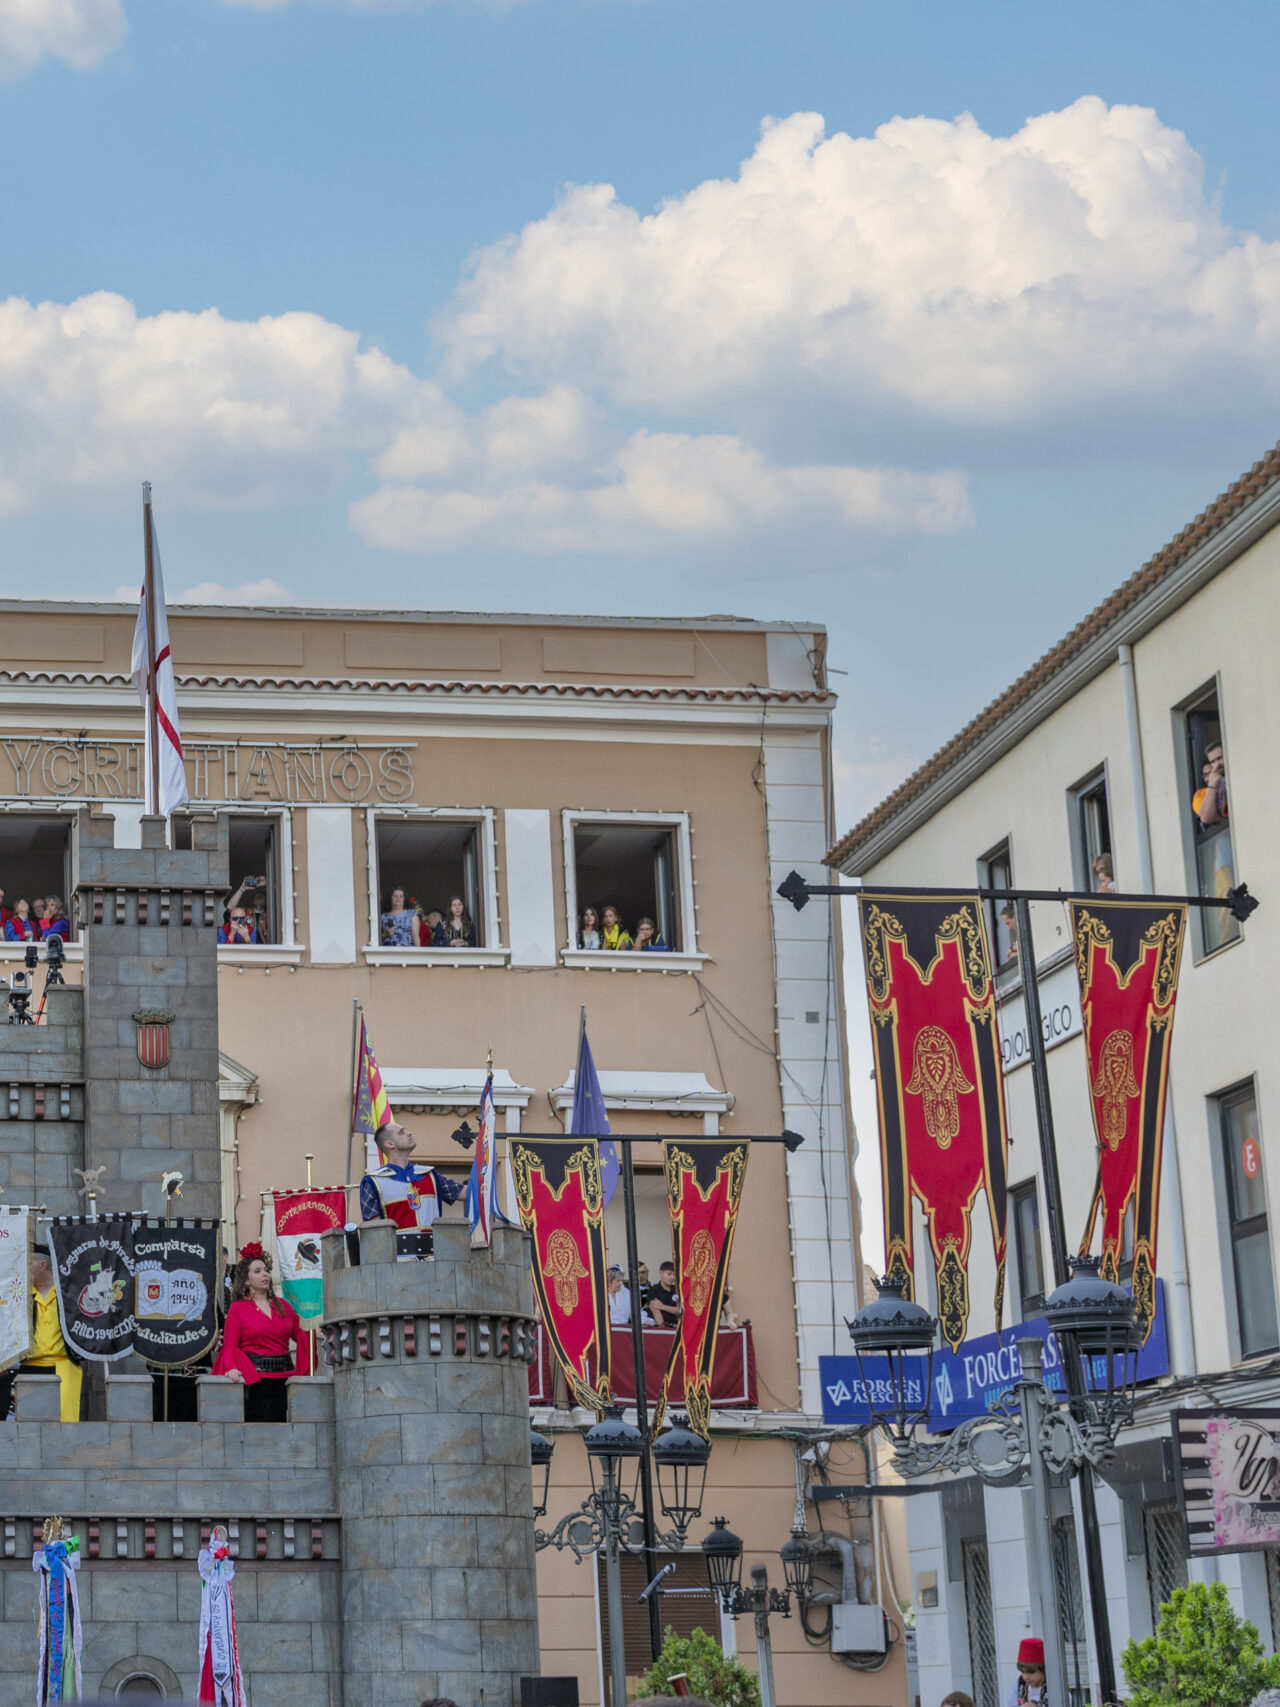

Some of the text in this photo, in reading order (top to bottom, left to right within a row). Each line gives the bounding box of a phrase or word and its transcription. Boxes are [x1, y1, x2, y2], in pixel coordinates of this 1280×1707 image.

[277, 1200, 341, 1233] CONTRABANDISTAS
[134, 1238, 206, 1261] Comparsa
[170, 1293, 196, 1305] 1944
